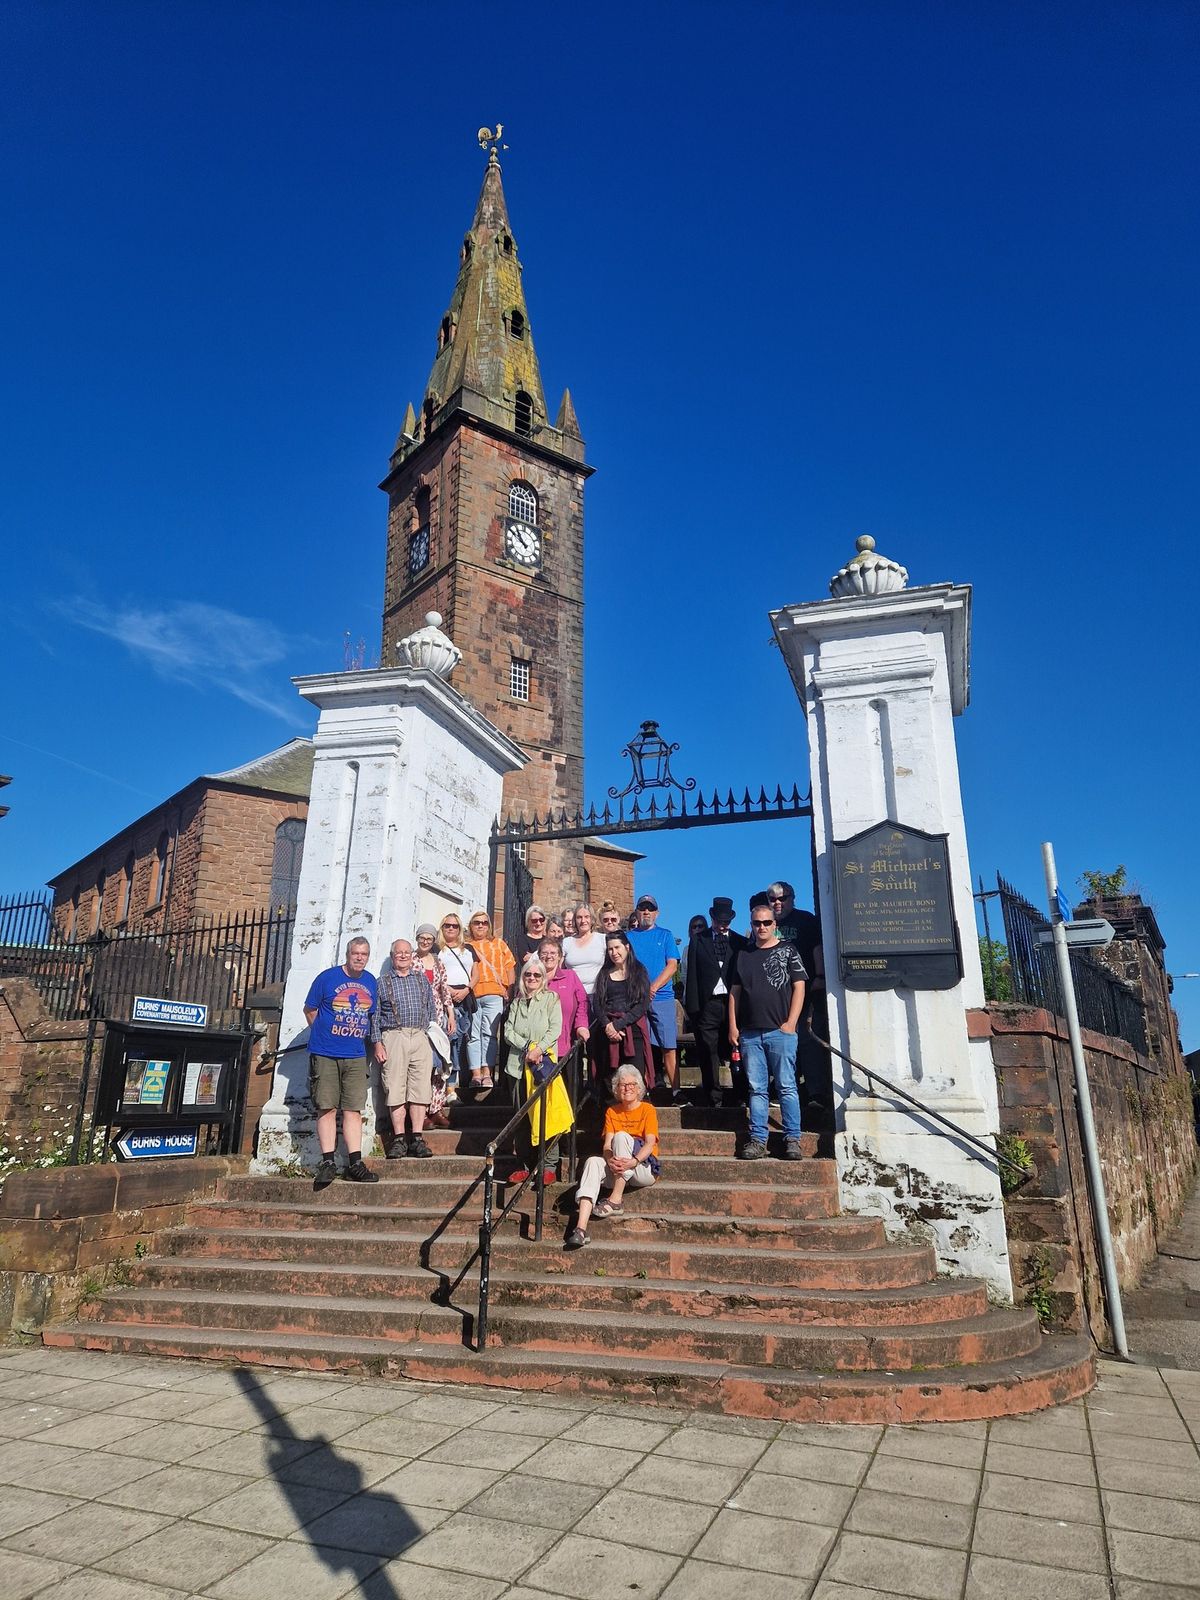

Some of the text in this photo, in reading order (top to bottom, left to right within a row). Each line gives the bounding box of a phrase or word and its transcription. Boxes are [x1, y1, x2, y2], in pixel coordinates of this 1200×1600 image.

[843, 857, 941, 878] St Michael's
[868, 878, 917, 895] South
[137, 1001, 198, 1015] BURNS' MAUSOLEUM
[136, 1010, 197, 1022] COVENANTERS MEMORIALS
[345, 1015, 359, 1024] OLD
[131, 1134, 193, 1149] BURNS' HOUSE
